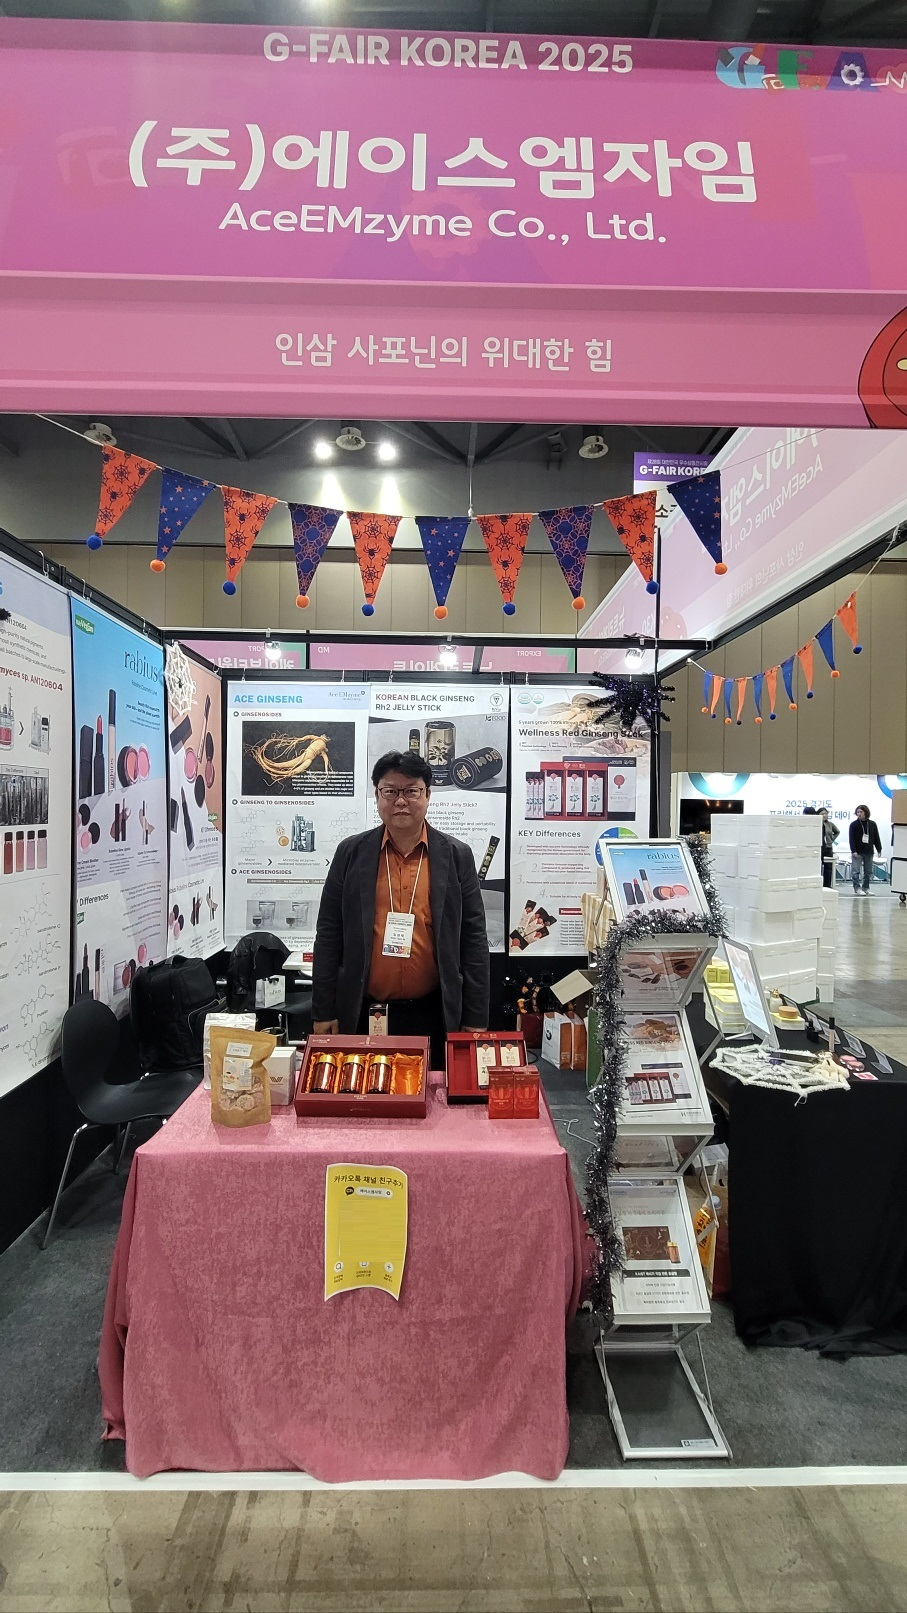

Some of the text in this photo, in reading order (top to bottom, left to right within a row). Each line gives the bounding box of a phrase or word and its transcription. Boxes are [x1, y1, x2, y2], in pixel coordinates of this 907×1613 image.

[263, 31, 633, 74] G-FAIR KOREA 2025
[128, 119, 757, 203] (주)에이스엠자임
[218, 202, 667, 246] AceEMzyme Co., Ltd.
[275, 332, 612, 373] 인삼 사포닌의 위대한 힘
[639, 464, 677, 476] G-FAIR
[123, 650, 158, 683] rabius
[31, 674, 63, 692] AN120604
[234, 694, 303, 704] ACE GINSENG
[375, 694, 409, 702] KOREAN
[519, 729, 560, 737] Wellness
[562, 729, 580, 737] Red
[582, 730, 619, 739] Ginseng
[786, 800, 808, 808] 2025
[834, 810, 850, 822] 데이
[535, 830, 581, 838] Differences
[647, 851, 680, 860] rabius
[333, 1174, 361, 1184] 카카오톡
[364, 1176, 377, 1184] 채널
